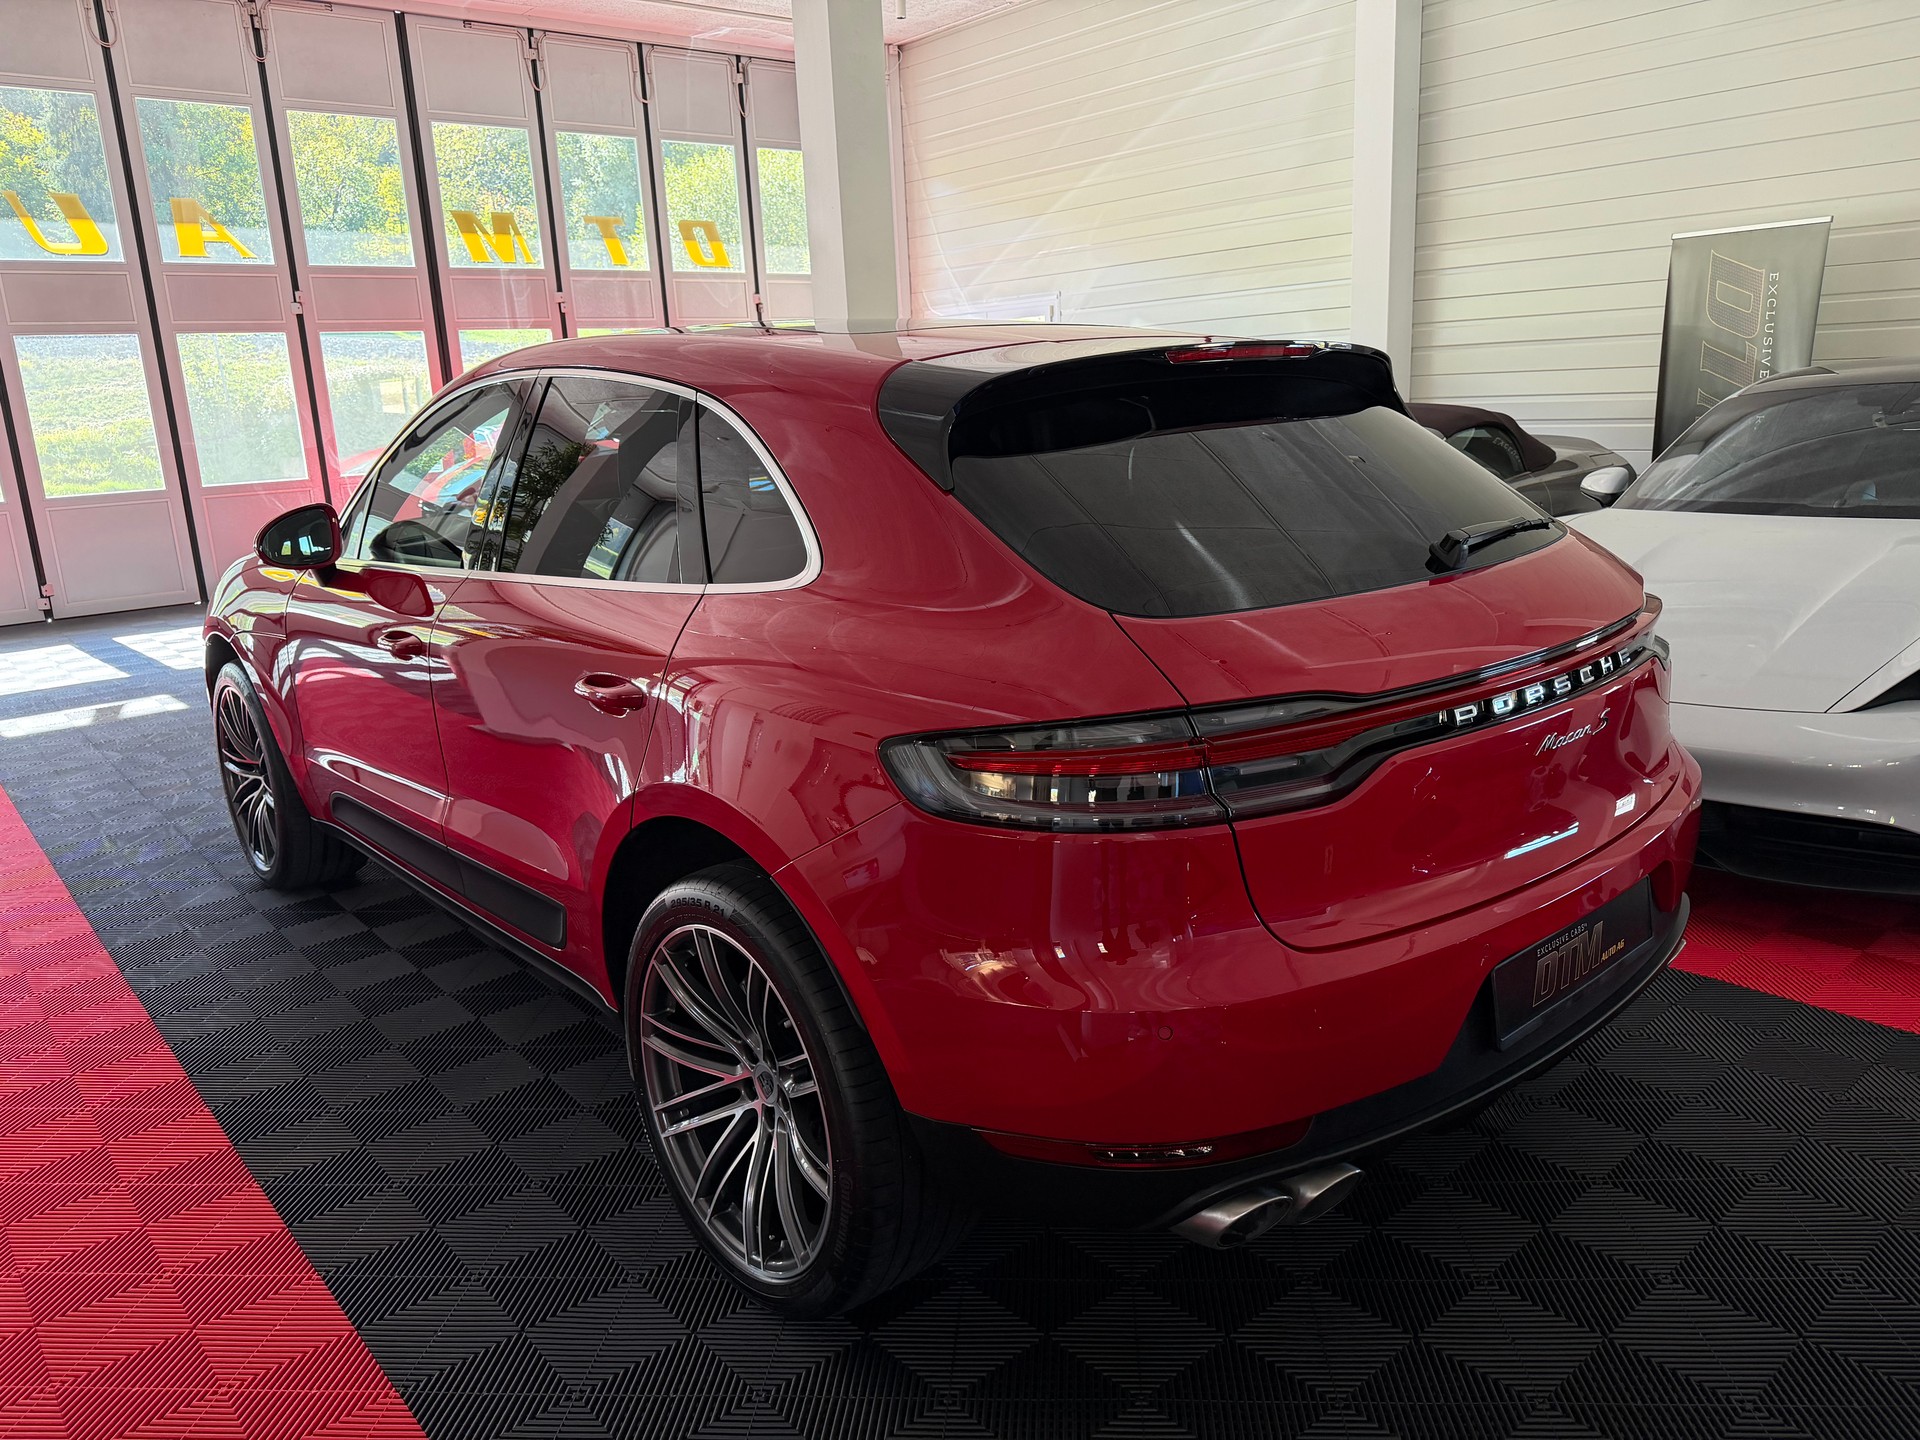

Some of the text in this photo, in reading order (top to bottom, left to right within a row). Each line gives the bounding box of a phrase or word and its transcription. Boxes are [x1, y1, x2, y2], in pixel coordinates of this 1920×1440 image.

[1760, 272, 1779, 378] EXCLUSIVE
[1454, 648, 1632, 727] PORSCHE
[1535, 707, 1611, 757] Macan S
[713, 904, 725, 917] 21
[1532, 920, 1603, 1008] DTM
[1537, 933, 1569, 957] EXCLUSIVE
